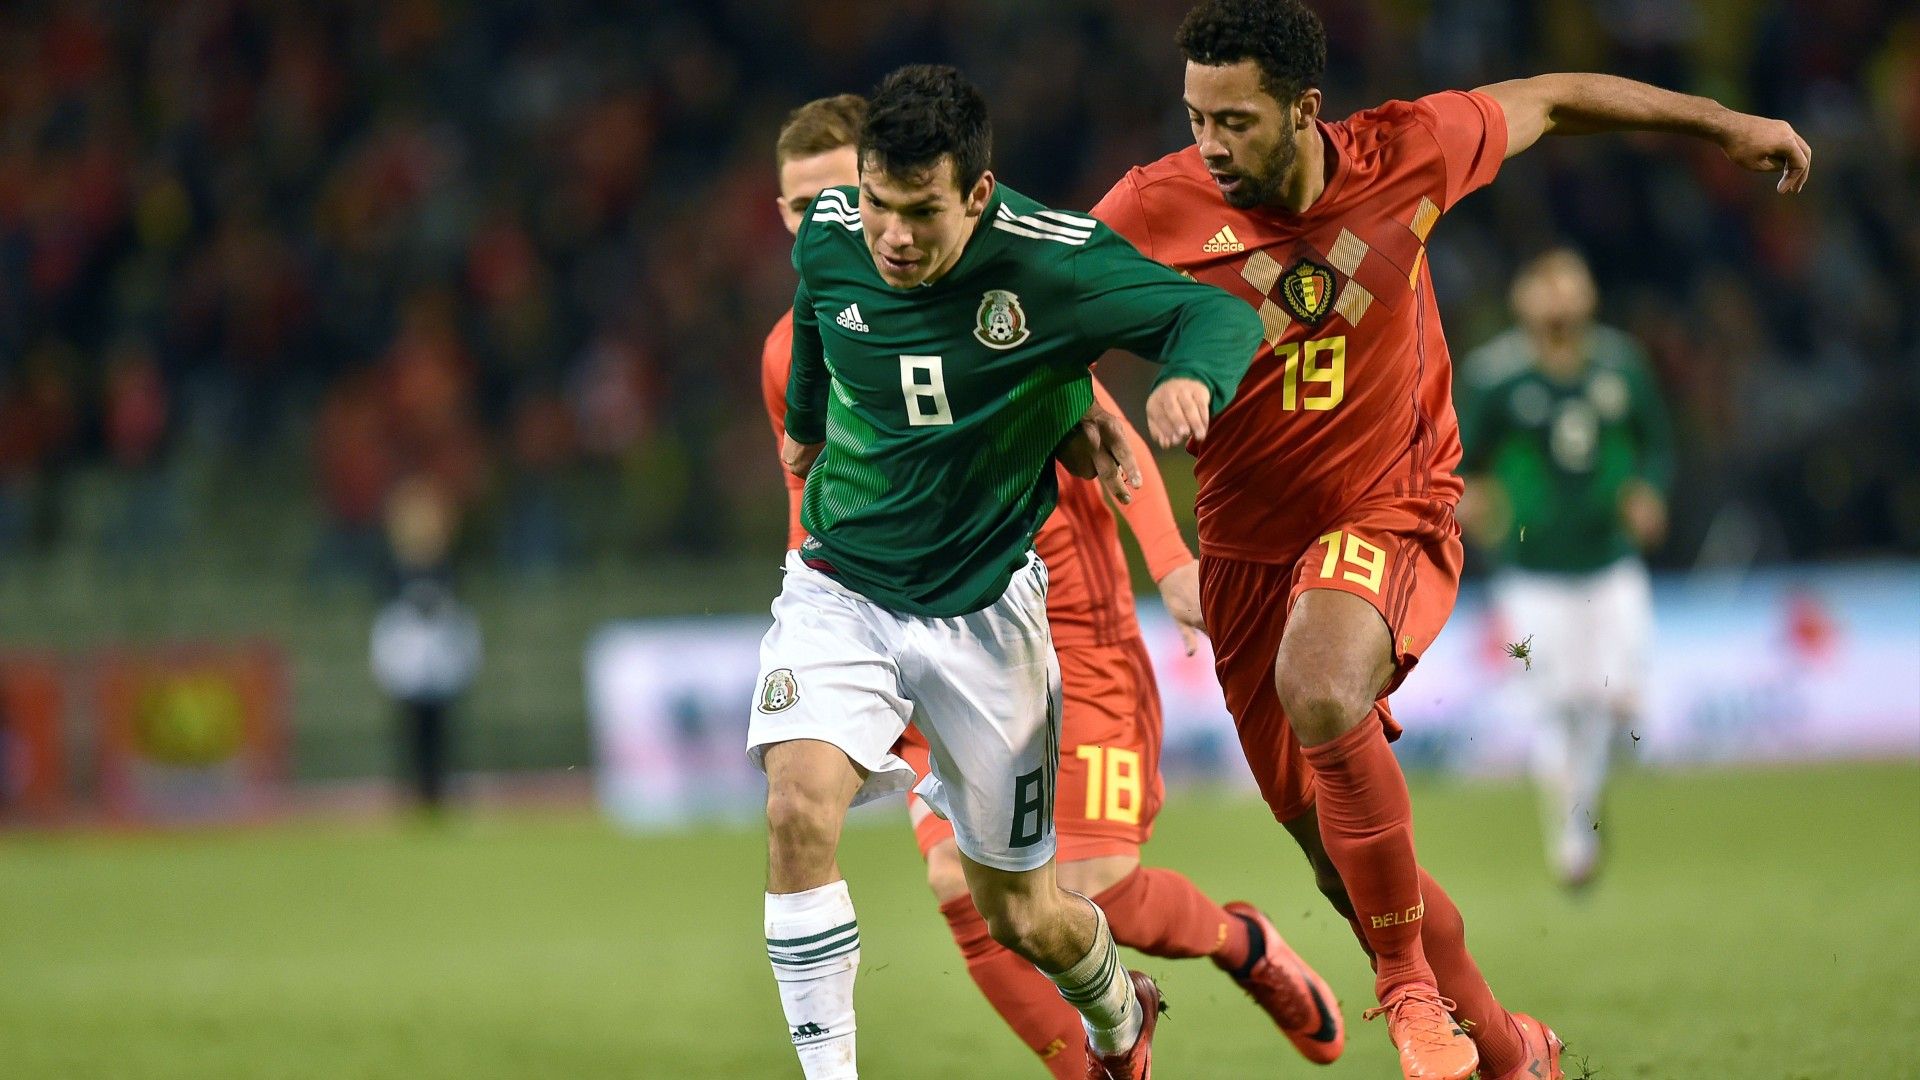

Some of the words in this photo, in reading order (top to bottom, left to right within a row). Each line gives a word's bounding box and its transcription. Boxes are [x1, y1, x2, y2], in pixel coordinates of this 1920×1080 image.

[1202, 241, 1245, 253] adidas
[836, 316, 870, 333] adidas
[899, 354, 954, 427] 8
[1274, 335, 1346, 412] 19
[1318, 530, 1387, 596] 19
[1008, 764, 1044, 849] 8
[1075, 744, 1142, 825] 18
